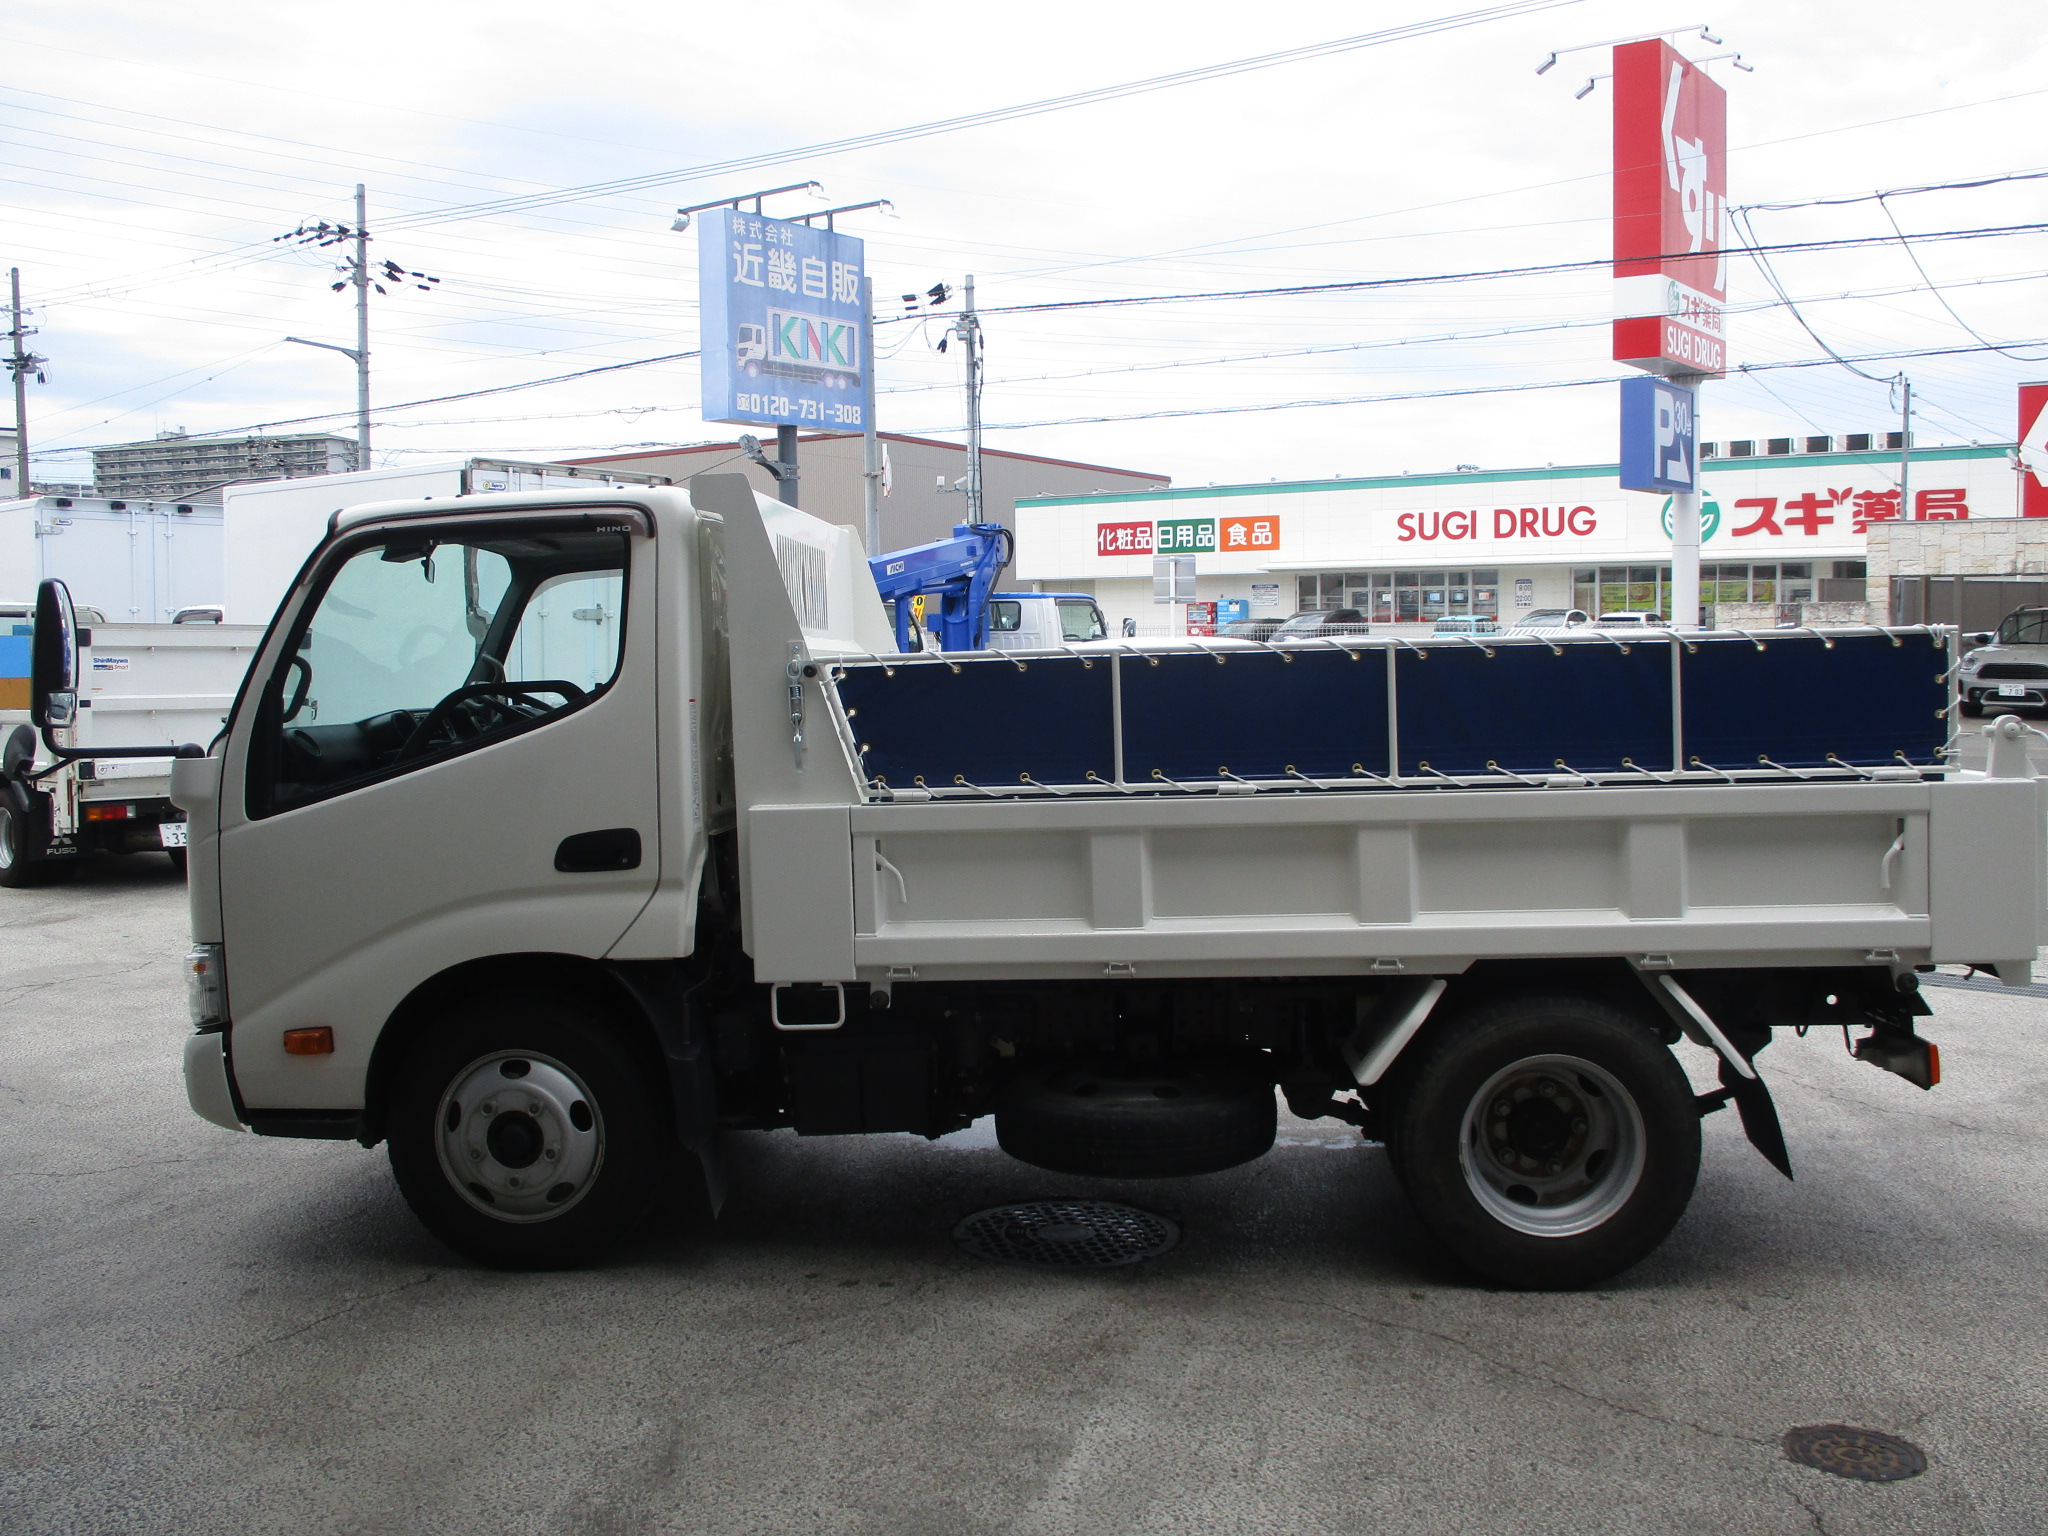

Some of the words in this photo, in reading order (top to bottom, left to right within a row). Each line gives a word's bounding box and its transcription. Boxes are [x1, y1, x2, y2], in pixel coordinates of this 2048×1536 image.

[732, 216, 793, 247] 株式会社
[733, 240, 860, 306] 近畿自販
[1680, 293, 1721, 333] スギ薬局
[1667, 325, 1692, 361] SUGI
[1694, 335, 1721, 369] DRUG
[750, 393, 861, 424] 0120-731-308
[596, 525, 632, 533] HINO
[1158, 524, 1215, 548] 日用品
[1227, 521, 1272, 547] 食品
[1397, 510, 1477, 542] SUGI
[1493, 505, 1597, 539] DRUG
[1098, 526, 1153, 551] 化粧品
[93, 657, 129, 665] ShinMaywa
[46, 847, 78, 856] FUSO
